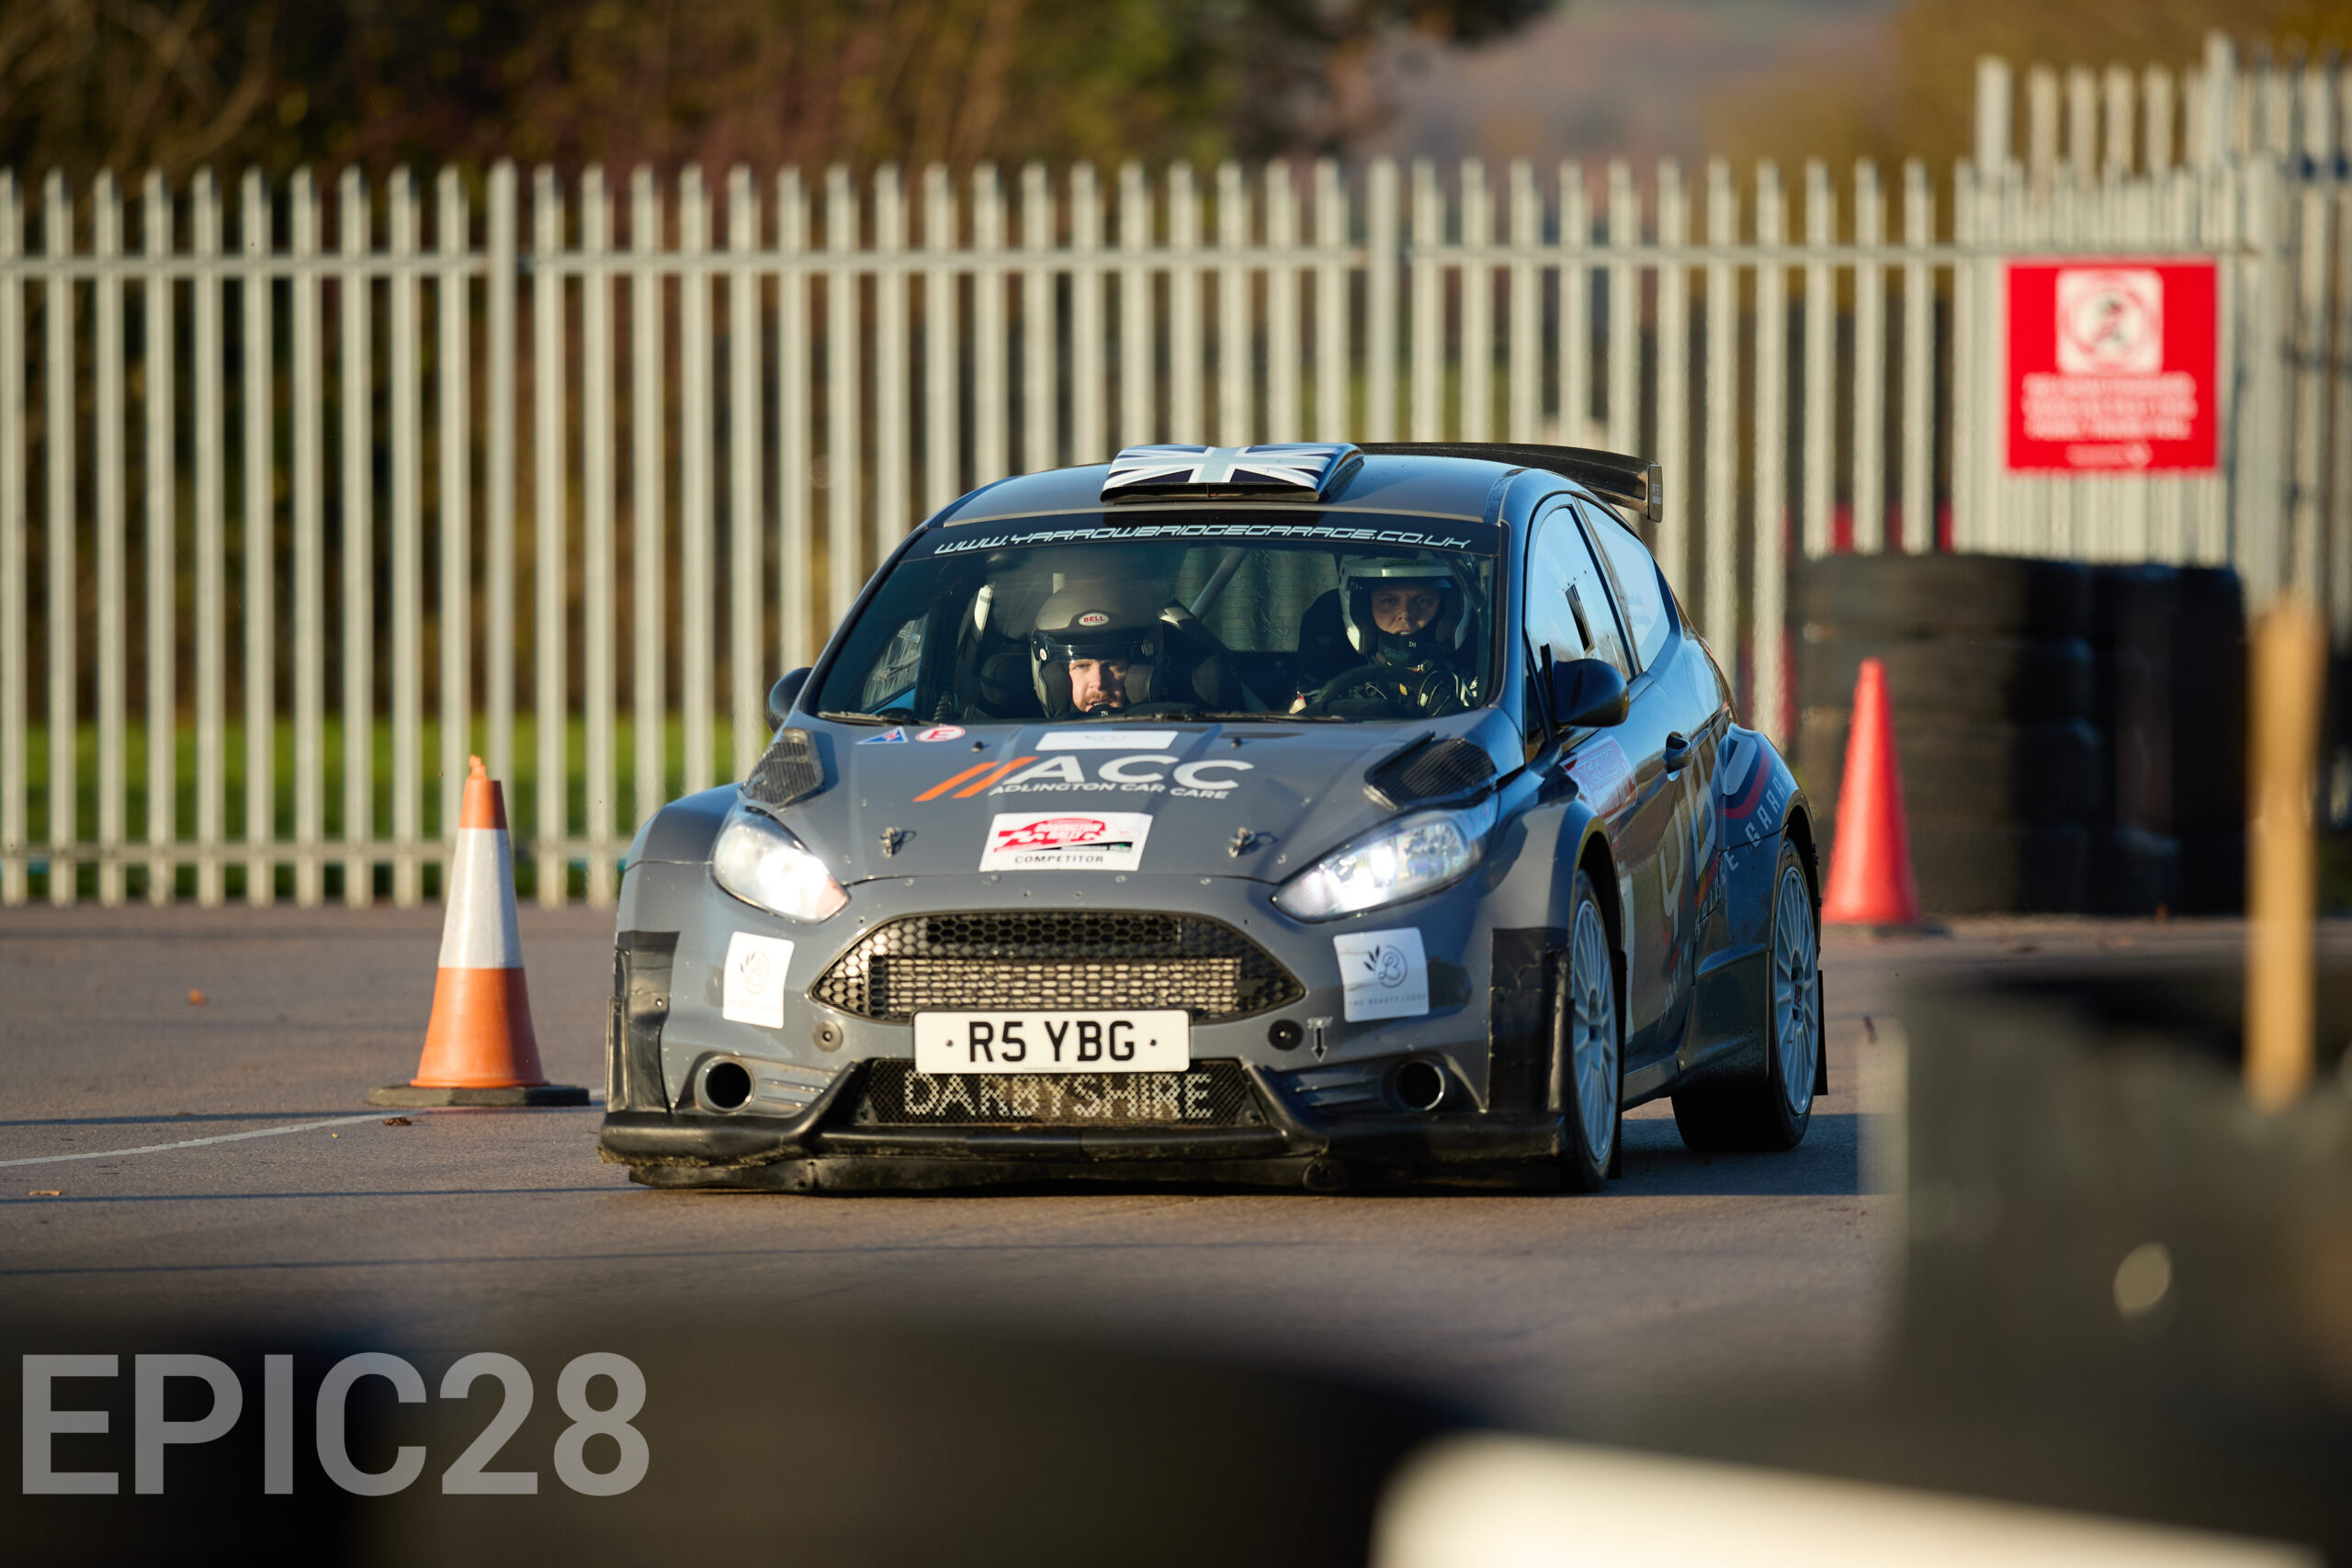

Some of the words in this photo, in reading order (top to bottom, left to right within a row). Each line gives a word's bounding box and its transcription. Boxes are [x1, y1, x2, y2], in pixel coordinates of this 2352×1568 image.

[1002, 754, 1255, 790] ACC
[988, 783, 1115, 796] ADLINGTON
[1120, 783, 1167, 794] CAR
[1170, 787, 1230, 800] CARE
[1014, 855, 1104, 864] COMPETITOR
[968, 1021, 1026, 1062] R5
[1045, 1021, 1136, 1062] YBG
[904, 1069, 1214, 1120] DARBYSHIRE
